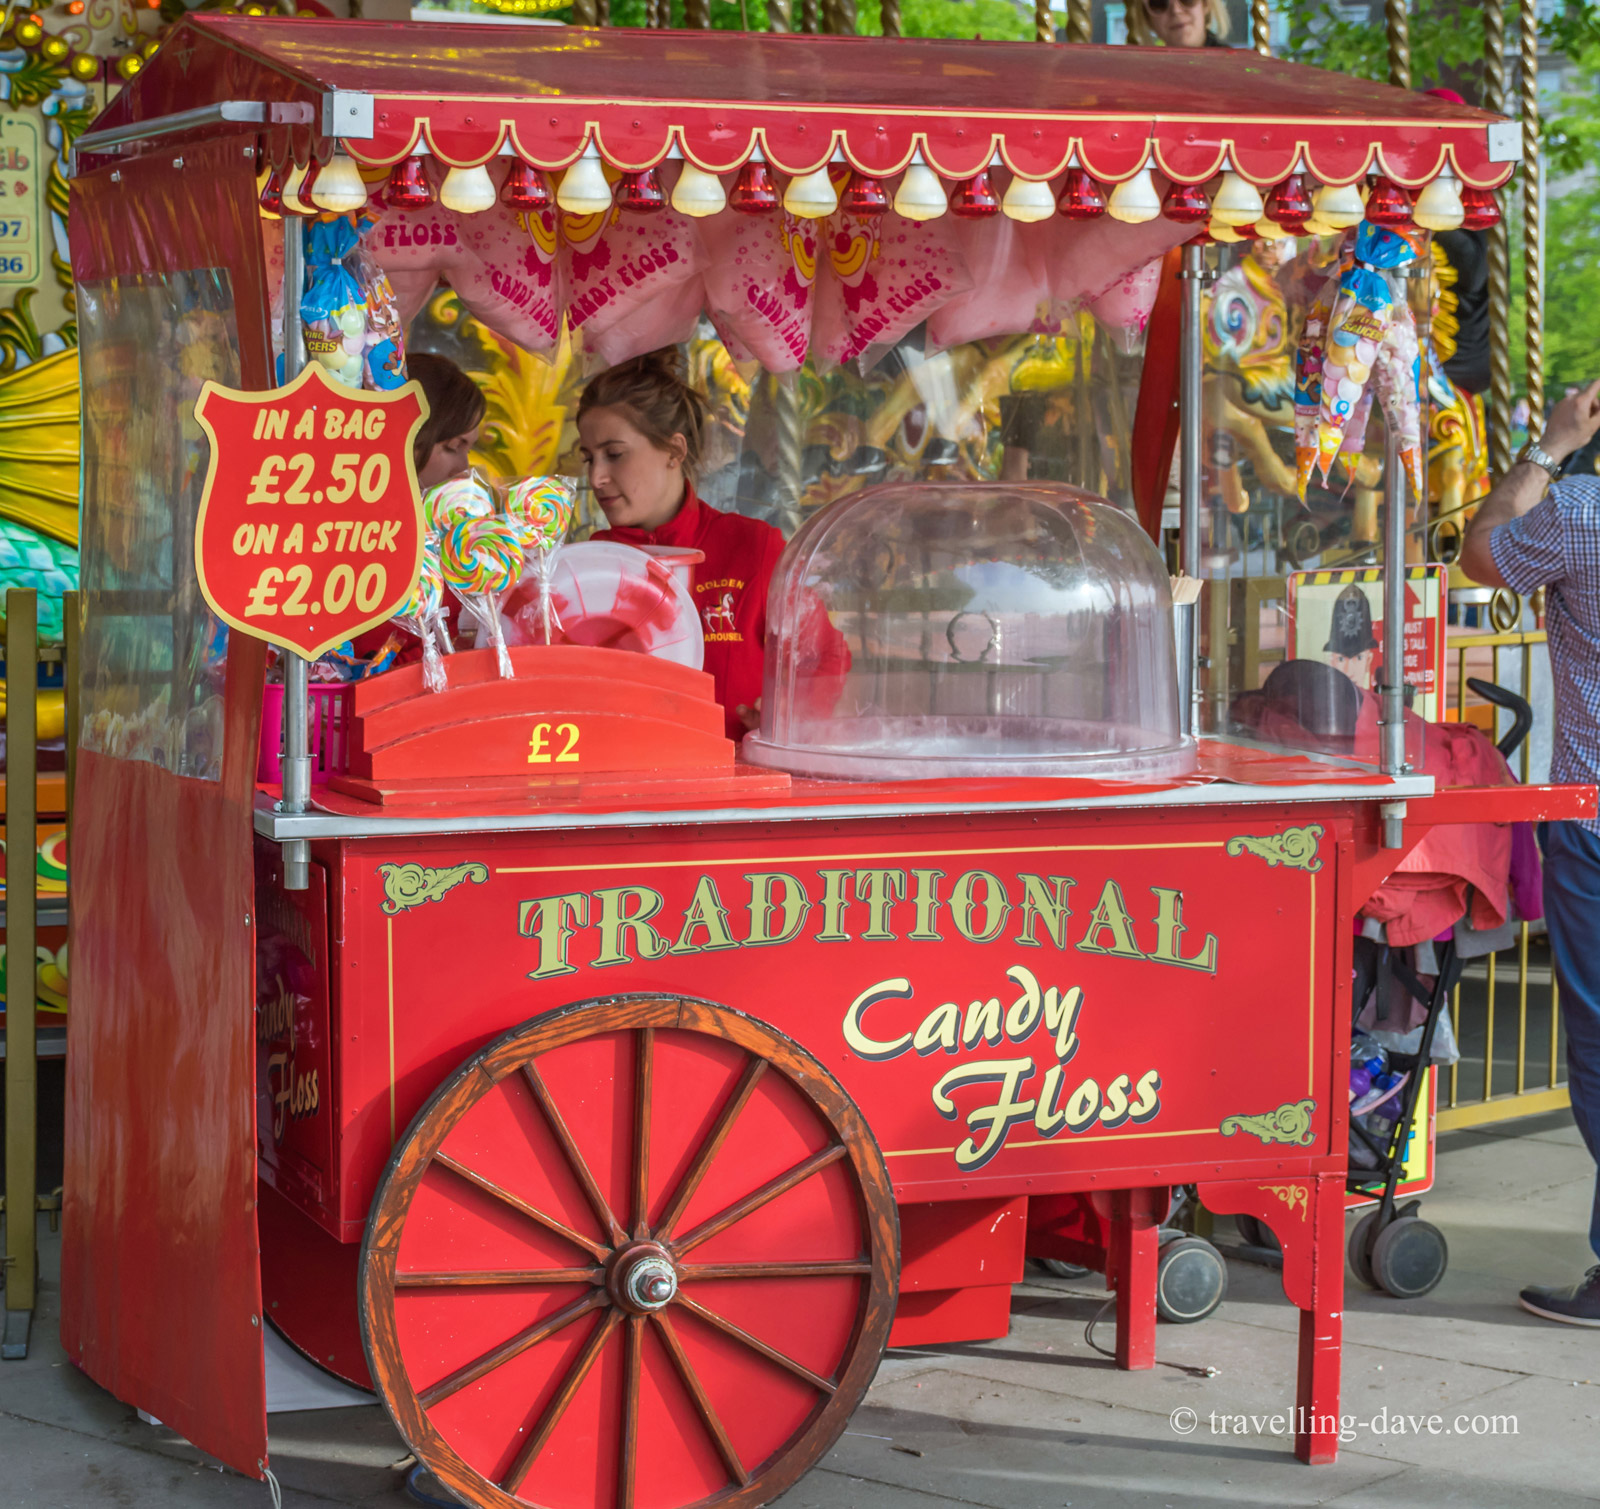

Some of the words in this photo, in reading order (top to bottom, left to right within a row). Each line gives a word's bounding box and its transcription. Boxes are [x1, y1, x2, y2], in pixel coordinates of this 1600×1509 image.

[384, 223, 458, 247] FLOSS
[491, 270, 535, 308] CANDY
[568, 277, 617, 332] ANDY
[616, 242, 679, 287] FLOSS
[747, 284, 791, 327] CANDY
[886, 271, 942, 314] FLOSS
[252, 408, 290, 440] IN
[293, 409, 315, 440] A
[323, 408, 386, 440] BAG
[246, 452, 391, 505] £2.50
[232, 523, 279, 556] ON
[283, 523, 304, 554] A
[312, 520, 402, 553] STICK
[244, 563, 387, 617] £2.00
[696, 578, 745, 593] GOLDEN
[704, 632, 744, 642] AROUSEL
[527, 723, 580, 763] £2
[518, 868, 1219, 981] TRADITIONAL
[257, 973, 296, 1052] andy
[842, 964, 1085, 1065] Candy
[268, 1052, 320, 1146] Floss
[931, 1056, 1162, 1172] Floss
